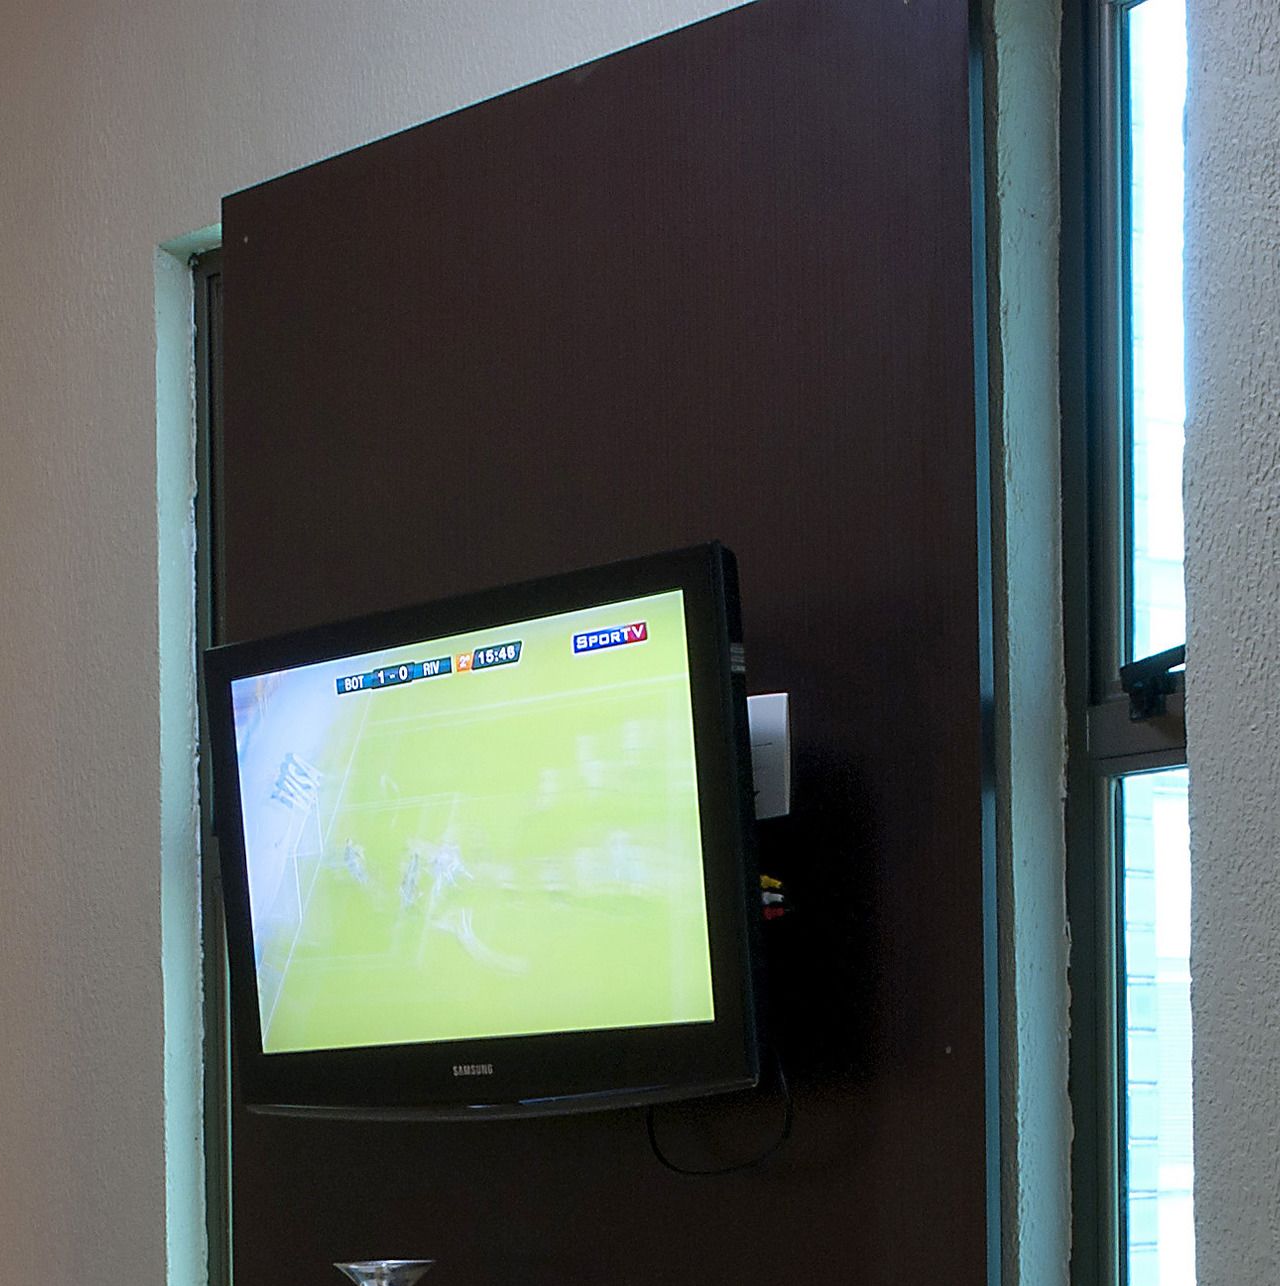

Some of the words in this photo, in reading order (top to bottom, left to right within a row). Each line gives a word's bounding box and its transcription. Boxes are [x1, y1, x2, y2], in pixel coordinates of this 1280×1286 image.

[344, 676, 364, 691] BOT
[378, 671, 385, 684] 1
[399, 666, 408, 681] 0
[423, 661, 440, 677] RIV
[452, 1063, 494, 1077] SAMSUNG
